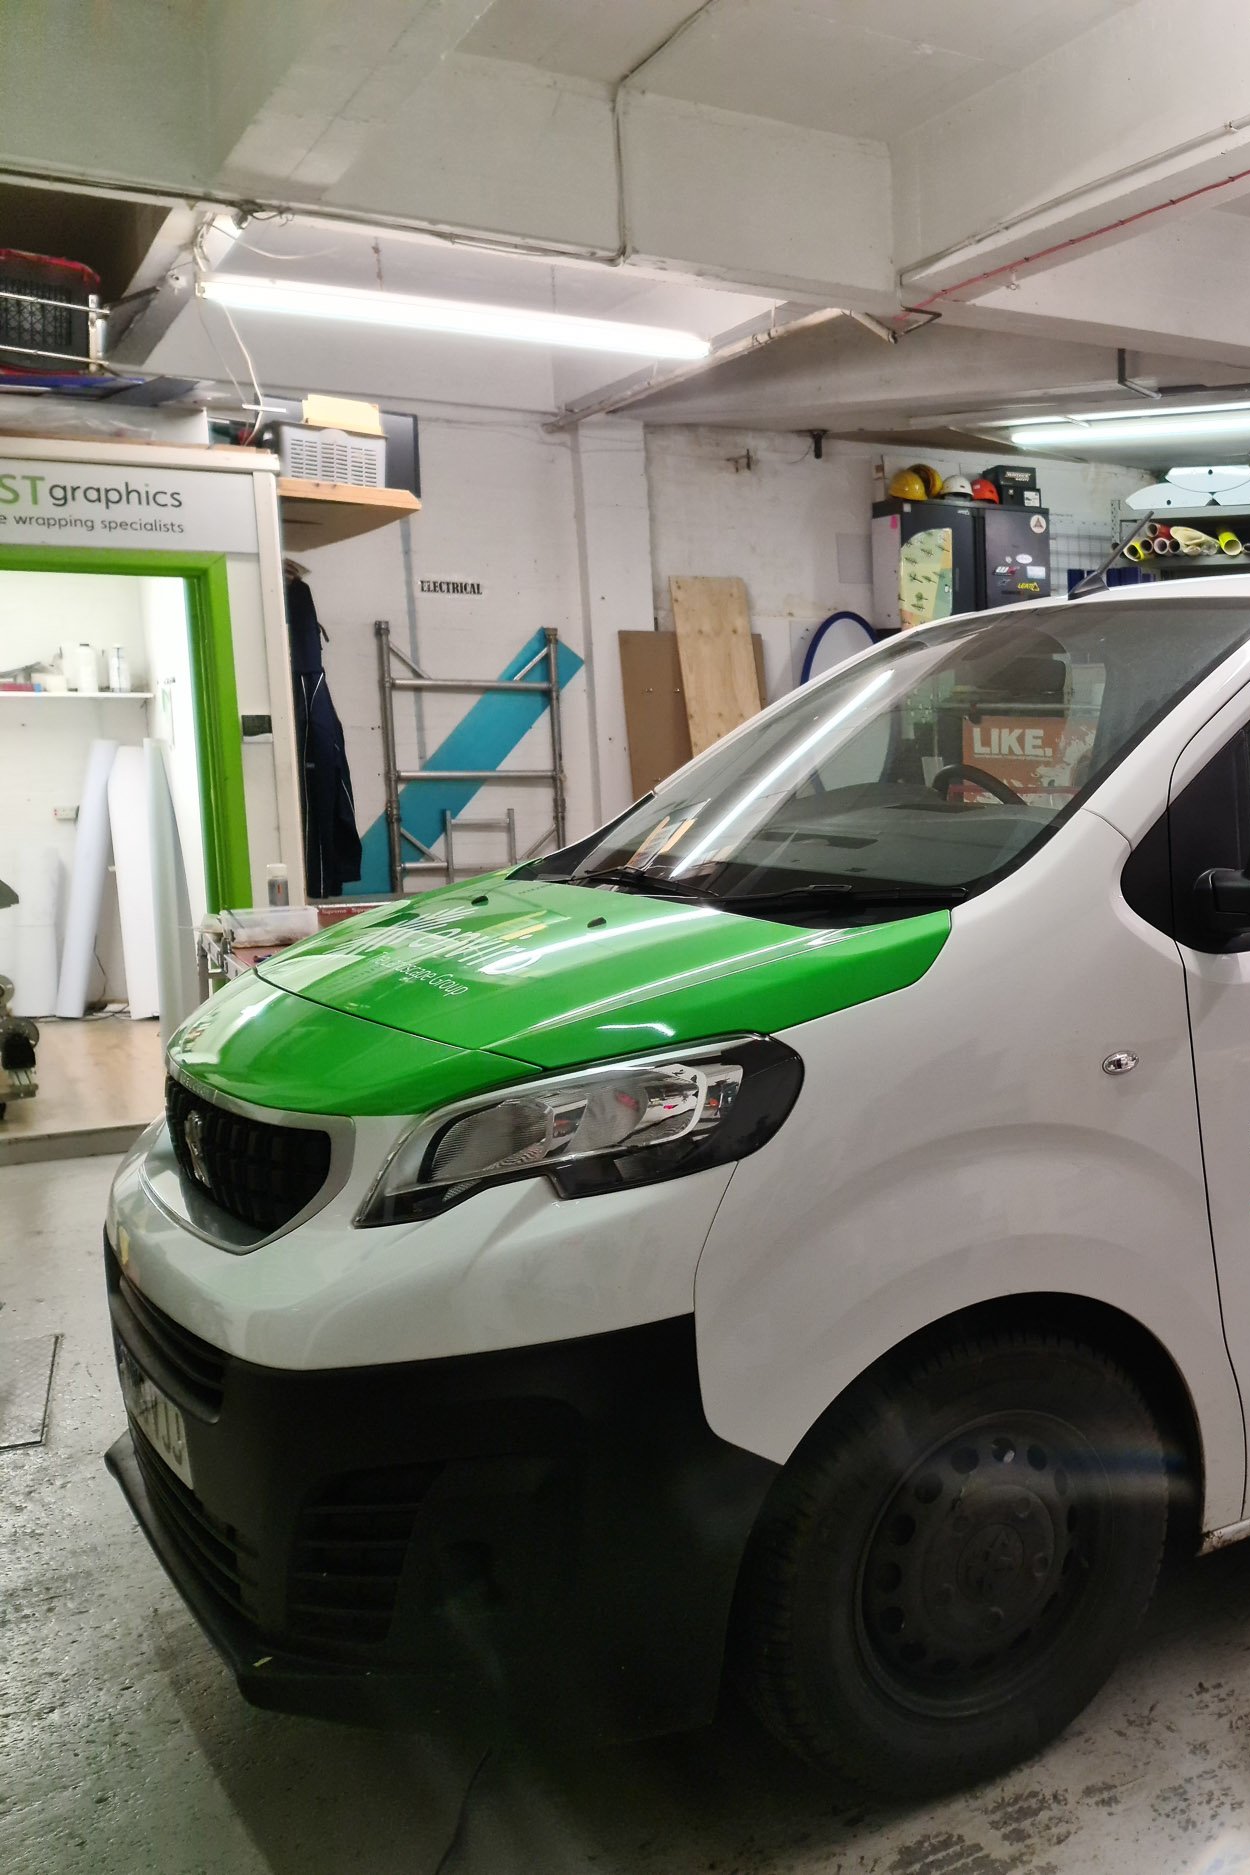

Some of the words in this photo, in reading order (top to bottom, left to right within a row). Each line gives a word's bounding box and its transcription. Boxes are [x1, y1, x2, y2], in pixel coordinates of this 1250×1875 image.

[49, 482, 182, 510] graphics
[13, 514, 95, 532] wrapping
[100, 518, 184, 533] specialists
[420, 580, 482, 595] ELECTRICAL
[972, 727, 1053, 757] LIKE.
[428, 973, 469, 997] Group
